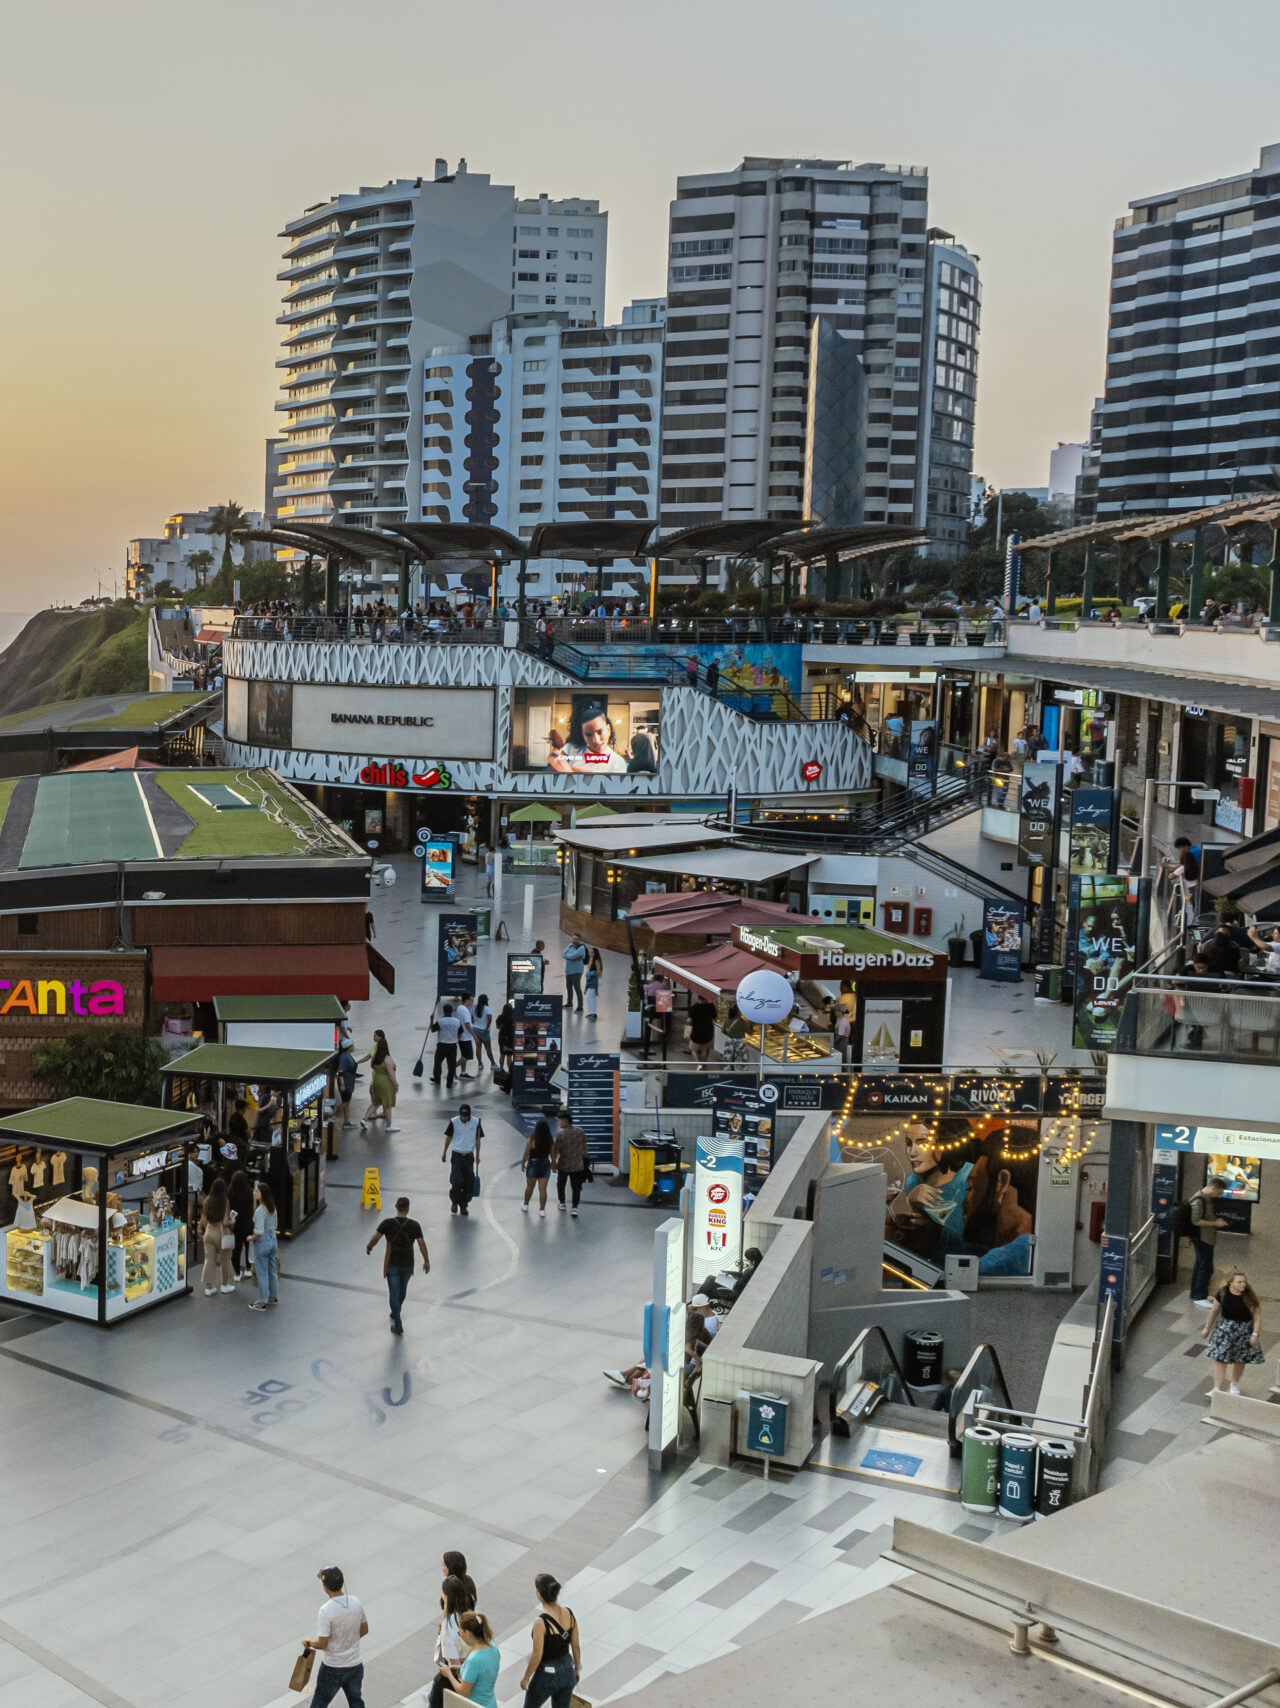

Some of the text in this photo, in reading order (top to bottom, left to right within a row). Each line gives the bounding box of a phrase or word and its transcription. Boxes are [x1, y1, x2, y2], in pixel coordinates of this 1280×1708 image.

[330, 713, 434, 727] BANANA REPUBLIC
[360, 761, 408, 787] chili's
[1030, 799, 1049, 808] WE
[1091, 937, 1123, 952] WE
[884, 1094, 928, 1104] KAIKAN
[1161, 1125, 1191, 1145] -2
[700, 1155, 717, 1168] -2
[708, 1217, 727, 1225] KING
